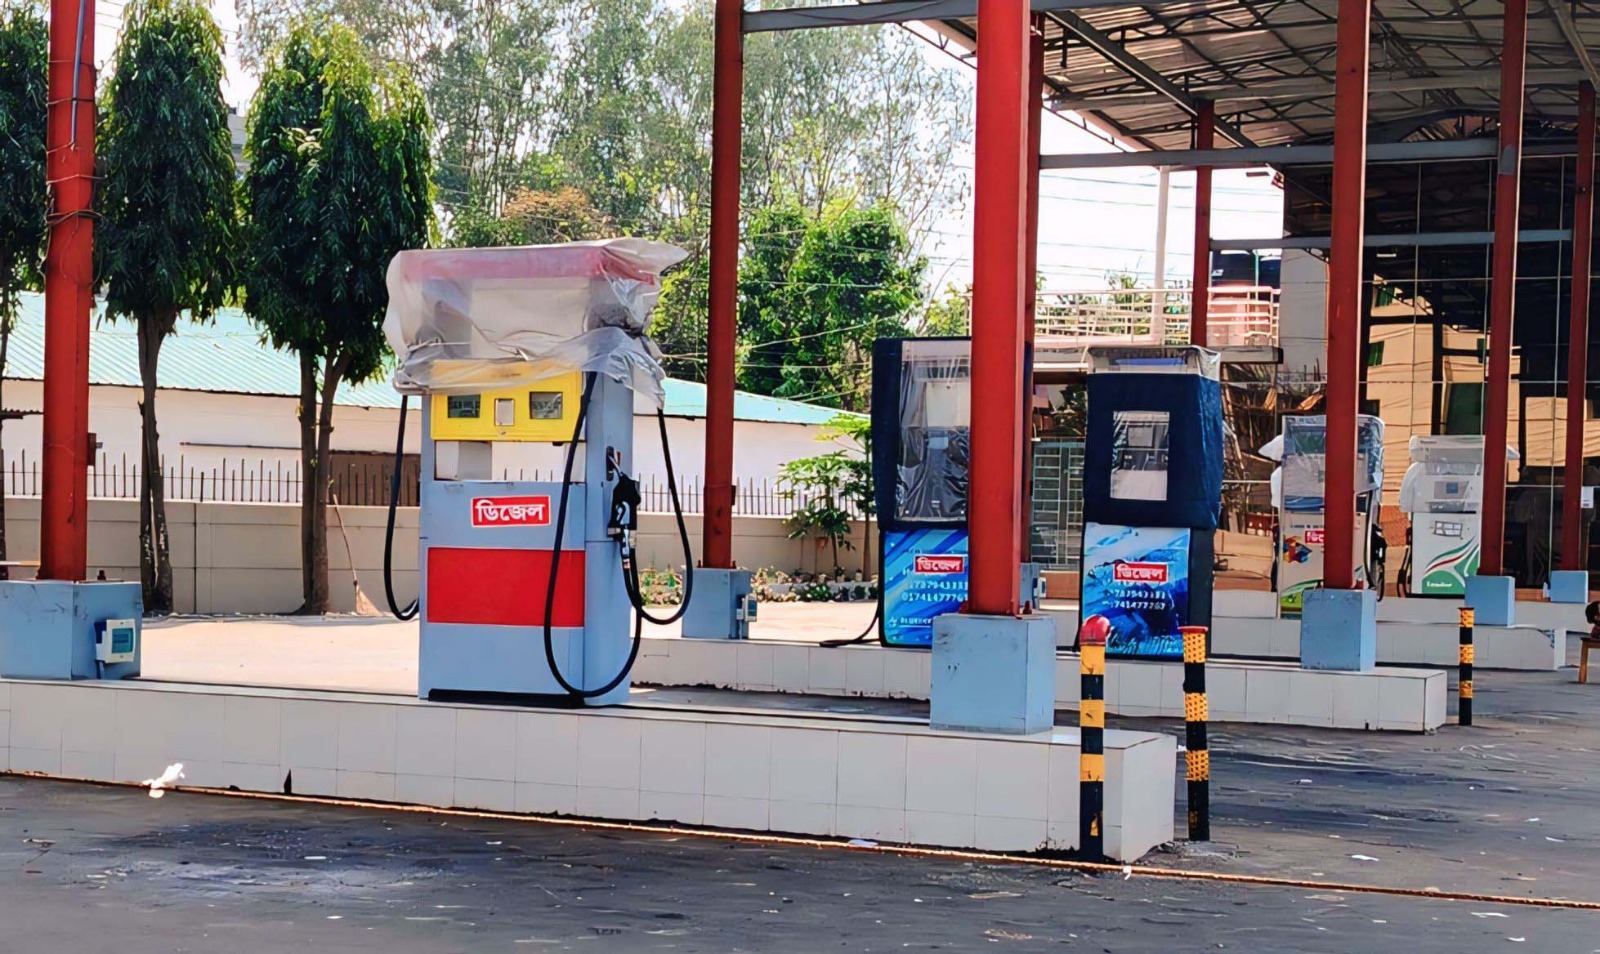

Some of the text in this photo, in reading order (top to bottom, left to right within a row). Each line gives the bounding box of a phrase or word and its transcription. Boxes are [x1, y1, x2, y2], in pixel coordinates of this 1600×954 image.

[475, 499, 546, 523] ডিজেল
[917, 556, 962, 571] ডিজেল
[1116, 563, 1164, 580] ডিজেল
